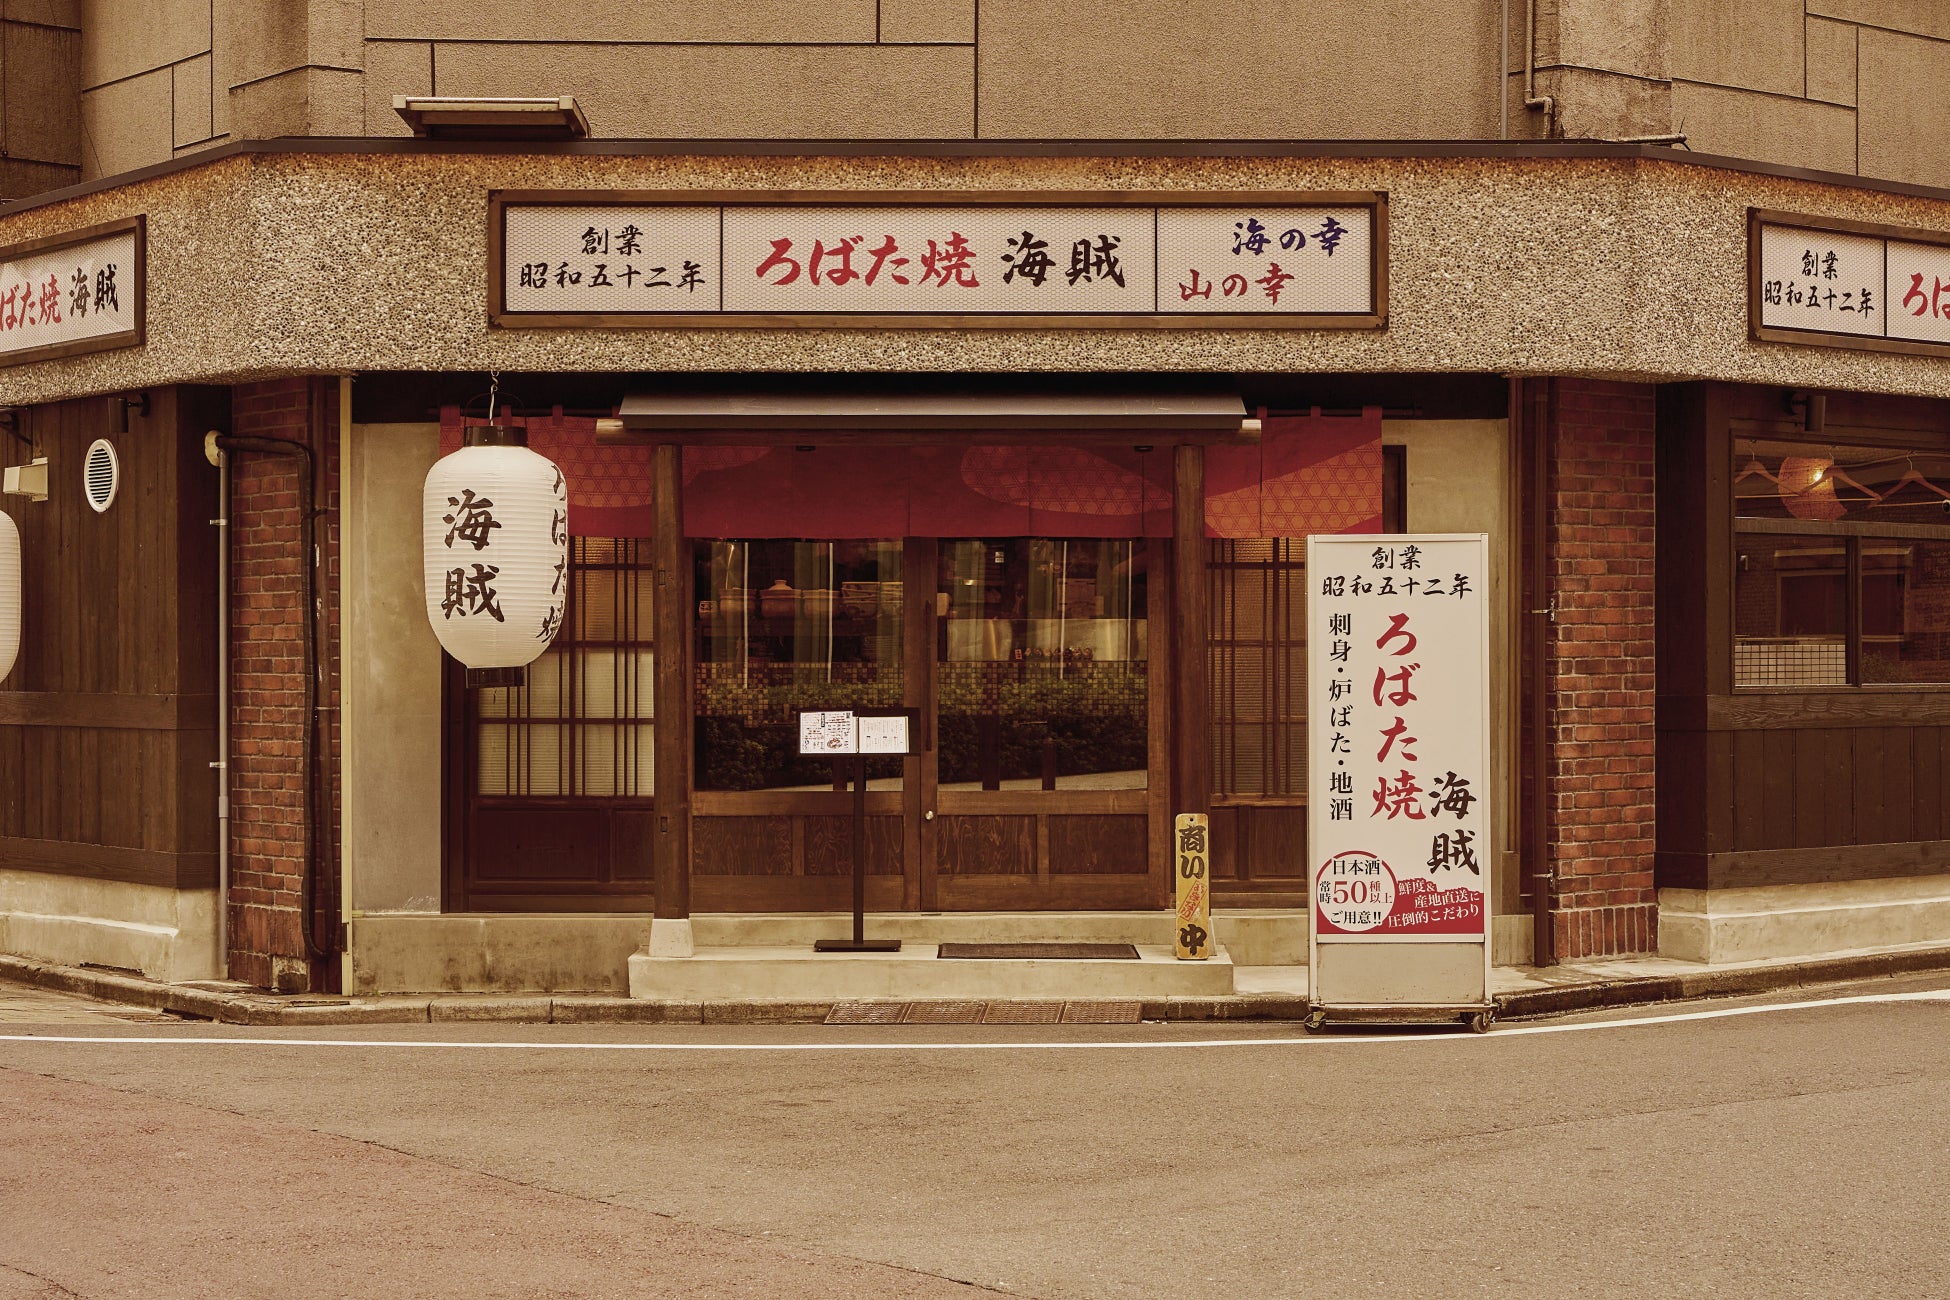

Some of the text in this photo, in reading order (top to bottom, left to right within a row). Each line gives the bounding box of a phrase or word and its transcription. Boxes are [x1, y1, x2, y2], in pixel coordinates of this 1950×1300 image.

[582, 225, 643, 256] 創業
[1232, 217, 1348, 256] 海の幸
[520, 261, 705, 293] 昭和五十二年
[756, 232, 1125, 287] ろばた焼 海賊
[1802, 250, 1838, 280] 創業
[70, 264, 118, 318] 海賊
[1179, 263, 1294, 305] 山の幸
[1765, 281, 1874, 319] 昭和五十二年
[442, 489, 504, 622] 海賊
[1372, 545, 1422, 569] 創業
[1322, 574, 1472, 599] 昭和五十二年
[1371, 613, 1425, 819] ろばた焼
[1427, 771, 1479, 875] 海賊
[1333, 860, 1380, 875] 日本酒
[1414, 888, 1479, 908] 産地直送に
[1388, 904, 1479, 928] 圧倒的こだわり
